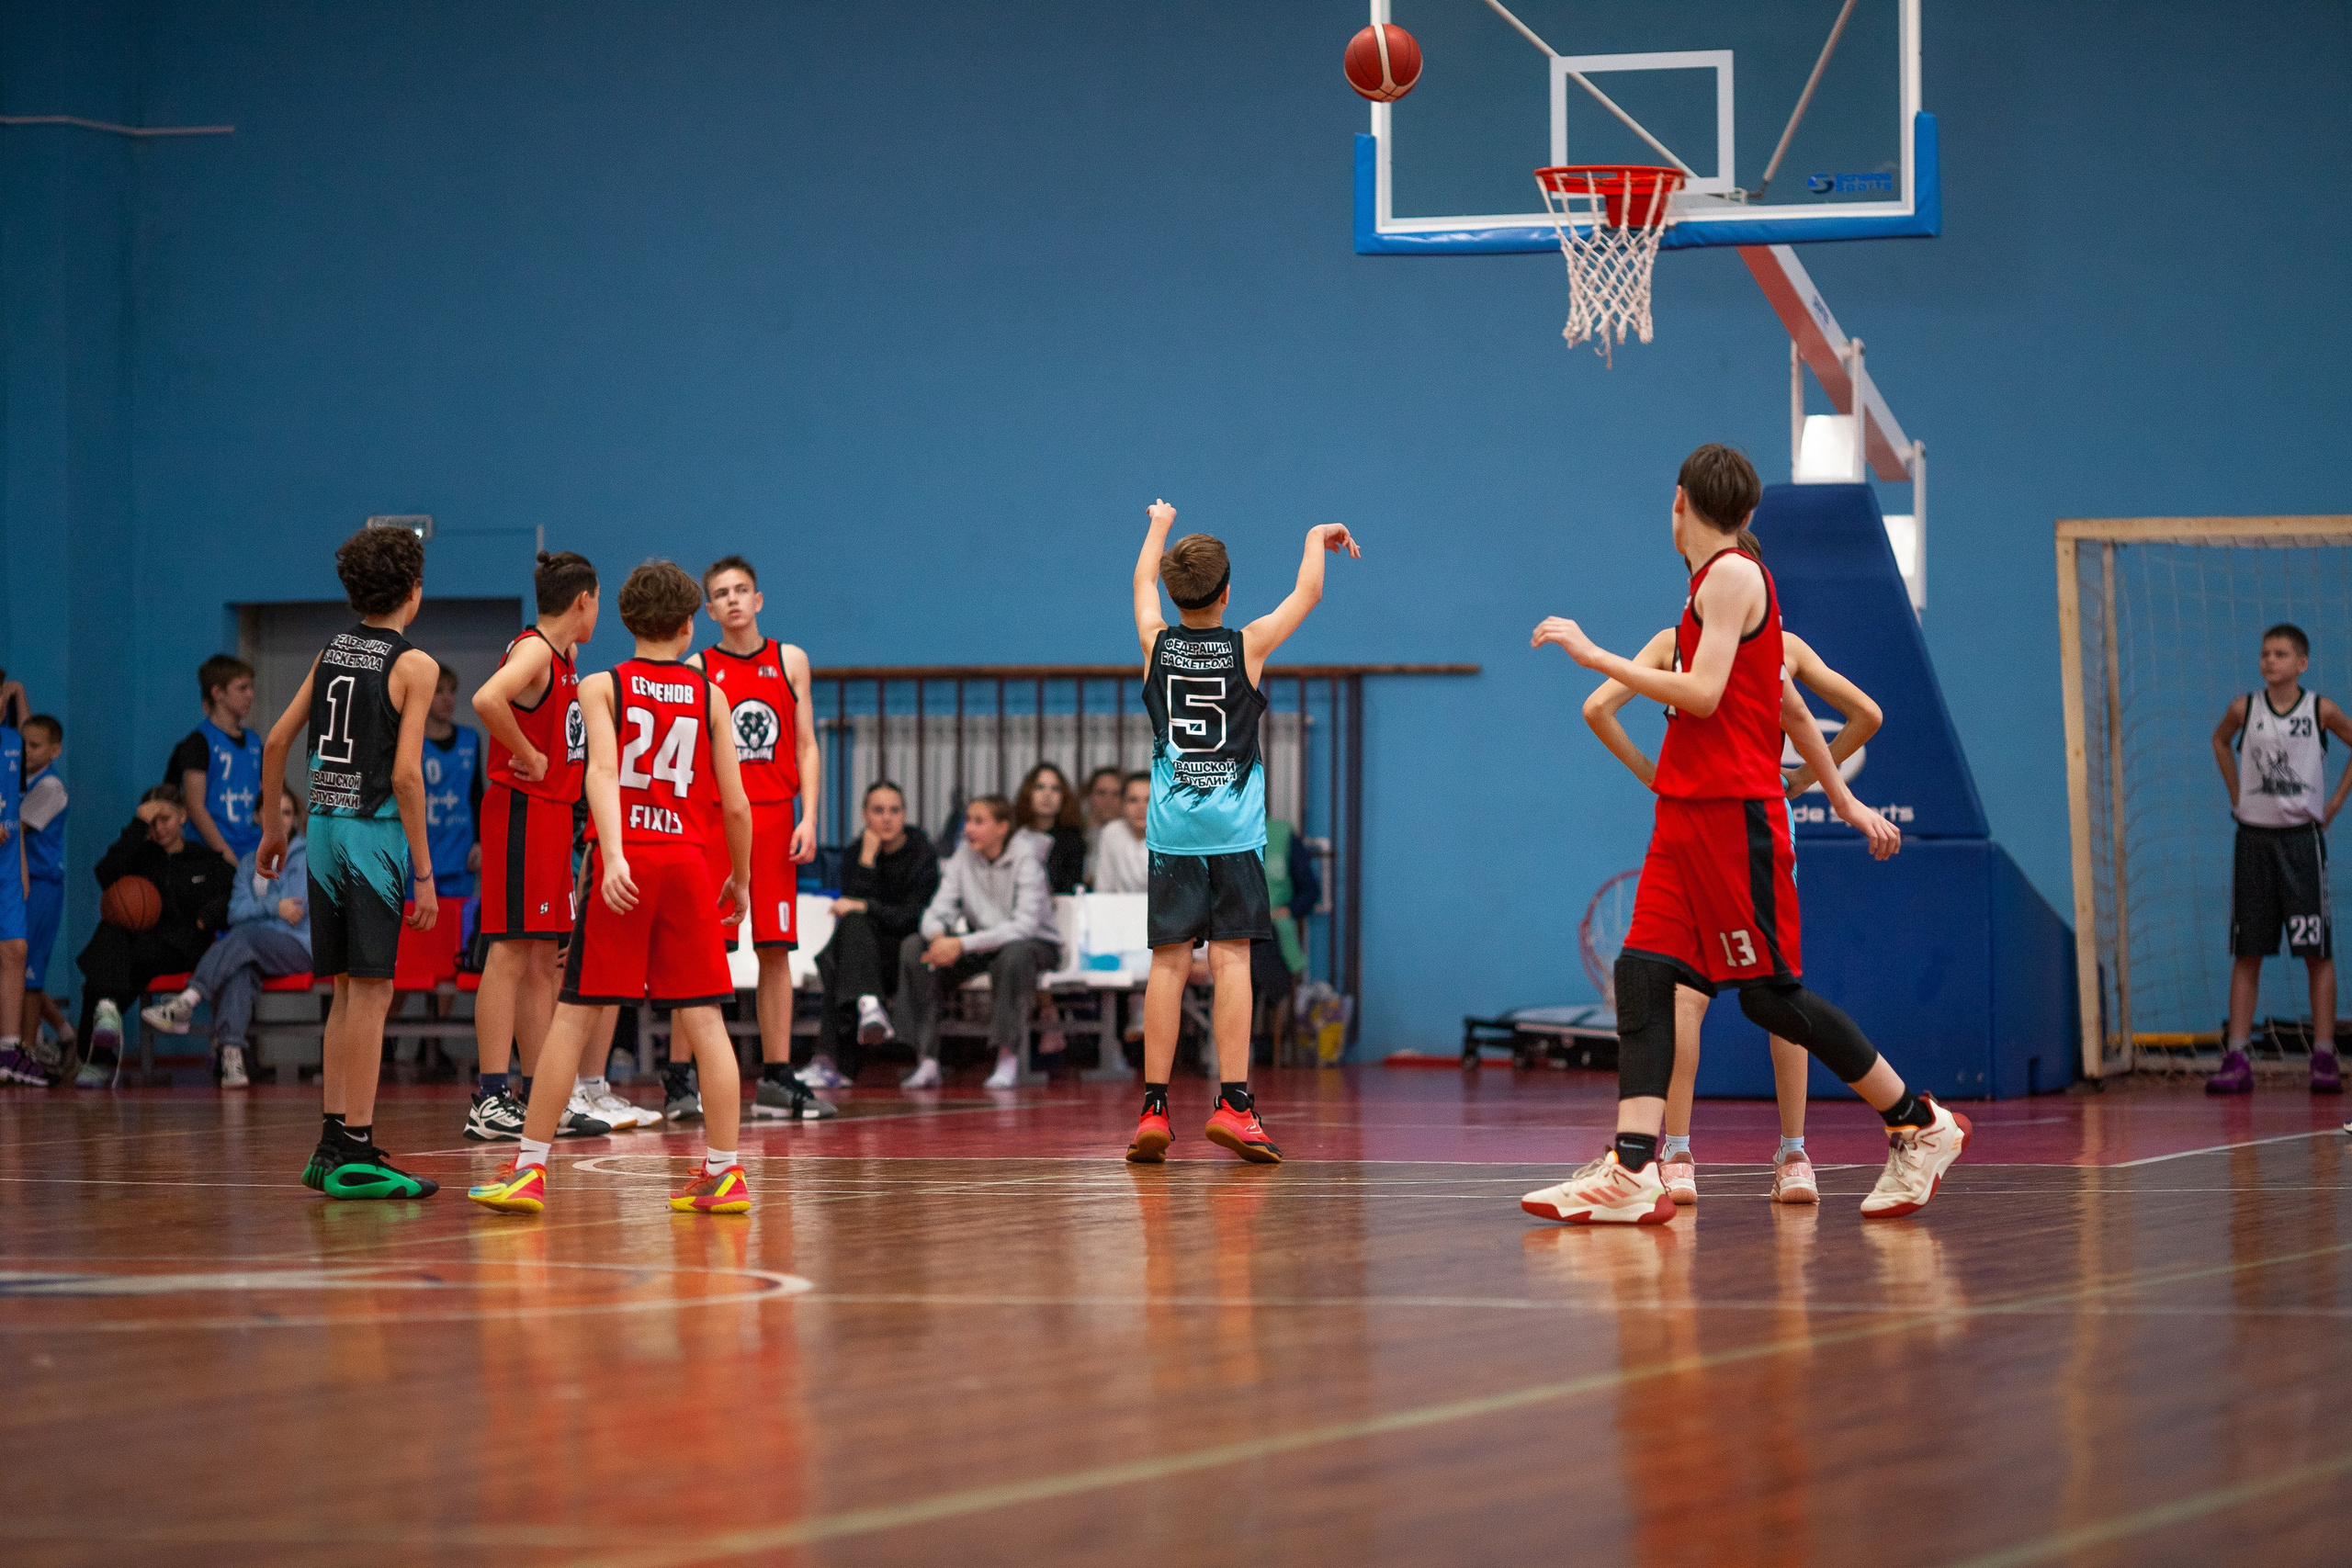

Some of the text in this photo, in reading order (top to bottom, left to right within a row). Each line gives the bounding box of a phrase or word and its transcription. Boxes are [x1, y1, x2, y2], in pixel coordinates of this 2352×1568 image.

[1160, 651, 1234, 670] БАСКЕТБОЛА
[1164, 638, 1233, 656] ФЕДЕРАЦИЯ
[630, 675, 694, 705] СЕМЕНОВ
[318, 675, 355, 763] 1
[1167, 675, 1226, 752] 5
[2290, 716, 2312, 738] 23
[619, 706, 699, 798] 24
[1170, 758, 1236, 774] УВАШСКОЙ
[310, 769, 361, 790] ВАШСКОЙ
[2290, 914, 2322, 945] 23
[1719, 929, 1757, 966] 13
